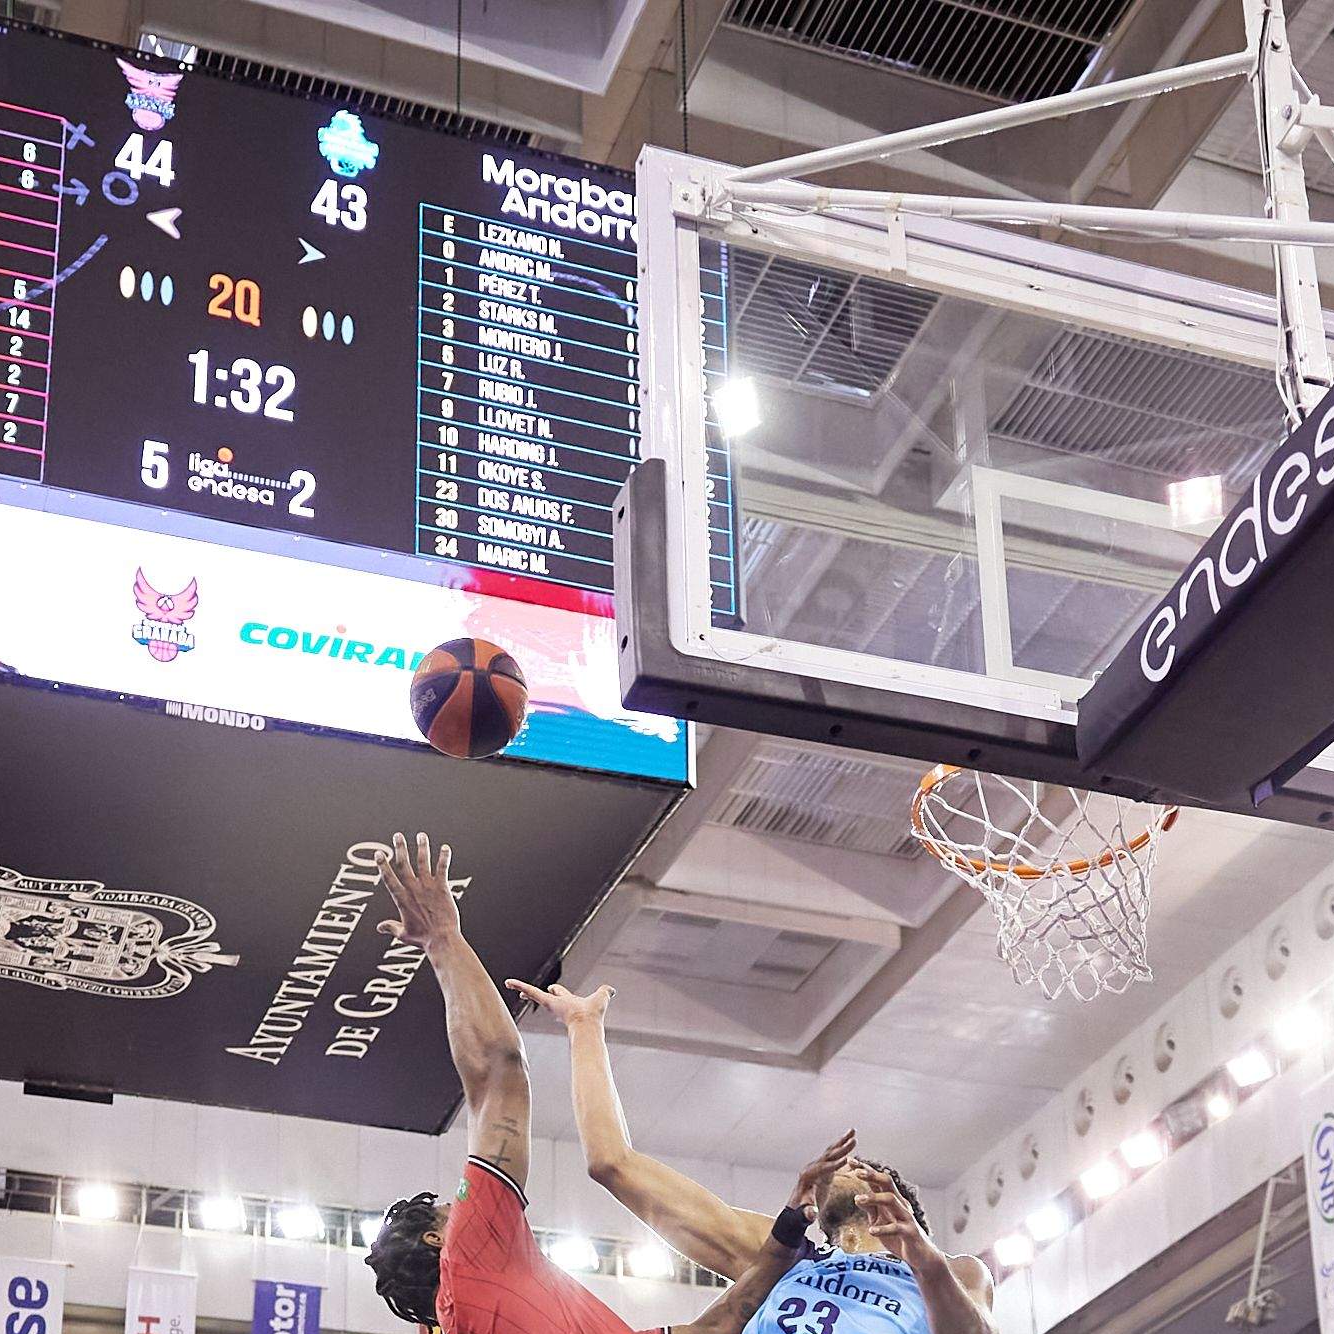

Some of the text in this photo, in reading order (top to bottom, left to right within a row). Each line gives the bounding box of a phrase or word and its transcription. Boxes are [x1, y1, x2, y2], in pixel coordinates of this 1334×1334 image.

[114, 132, 368, 232] 44 43
[443, 215, 455, 234] E
[444, 267, 454, 285] 1
[207, 274, 261, 327] 2Q
[442, 293, 455, 312] 2
[9, 307, 30, 330] 14
[442, 319, 455, 338] 3
[10, 335, 23, 357] 2
[7, 364, 21, 386] 2
[478, 352, 510, 376] LUZ
[187, 349, 297, 423] 1:32
[441, 372, 454, 391] 7
[5, 393, 20, 413] 7
[441, 399, 537, 435] 9 LLOVET
[3, 421, 18, 443] 2
[437, 426, 459, 446] 10
[140, 440, 169, 490] 5
[188, 451, 230, 478] liga
[437, 452, 457, 474] 11
[187, 477, 275, 506] endesa
[287, 470, 315, 518] 2
[435, 508, 459, 529] 30
[435, 536, 459, 558] 34
[181, 702, 266, 732] MONDO
[225, 841, 394, 1066] AYUNTAMIENTO
[325, 1016, 381, 1060] DE
